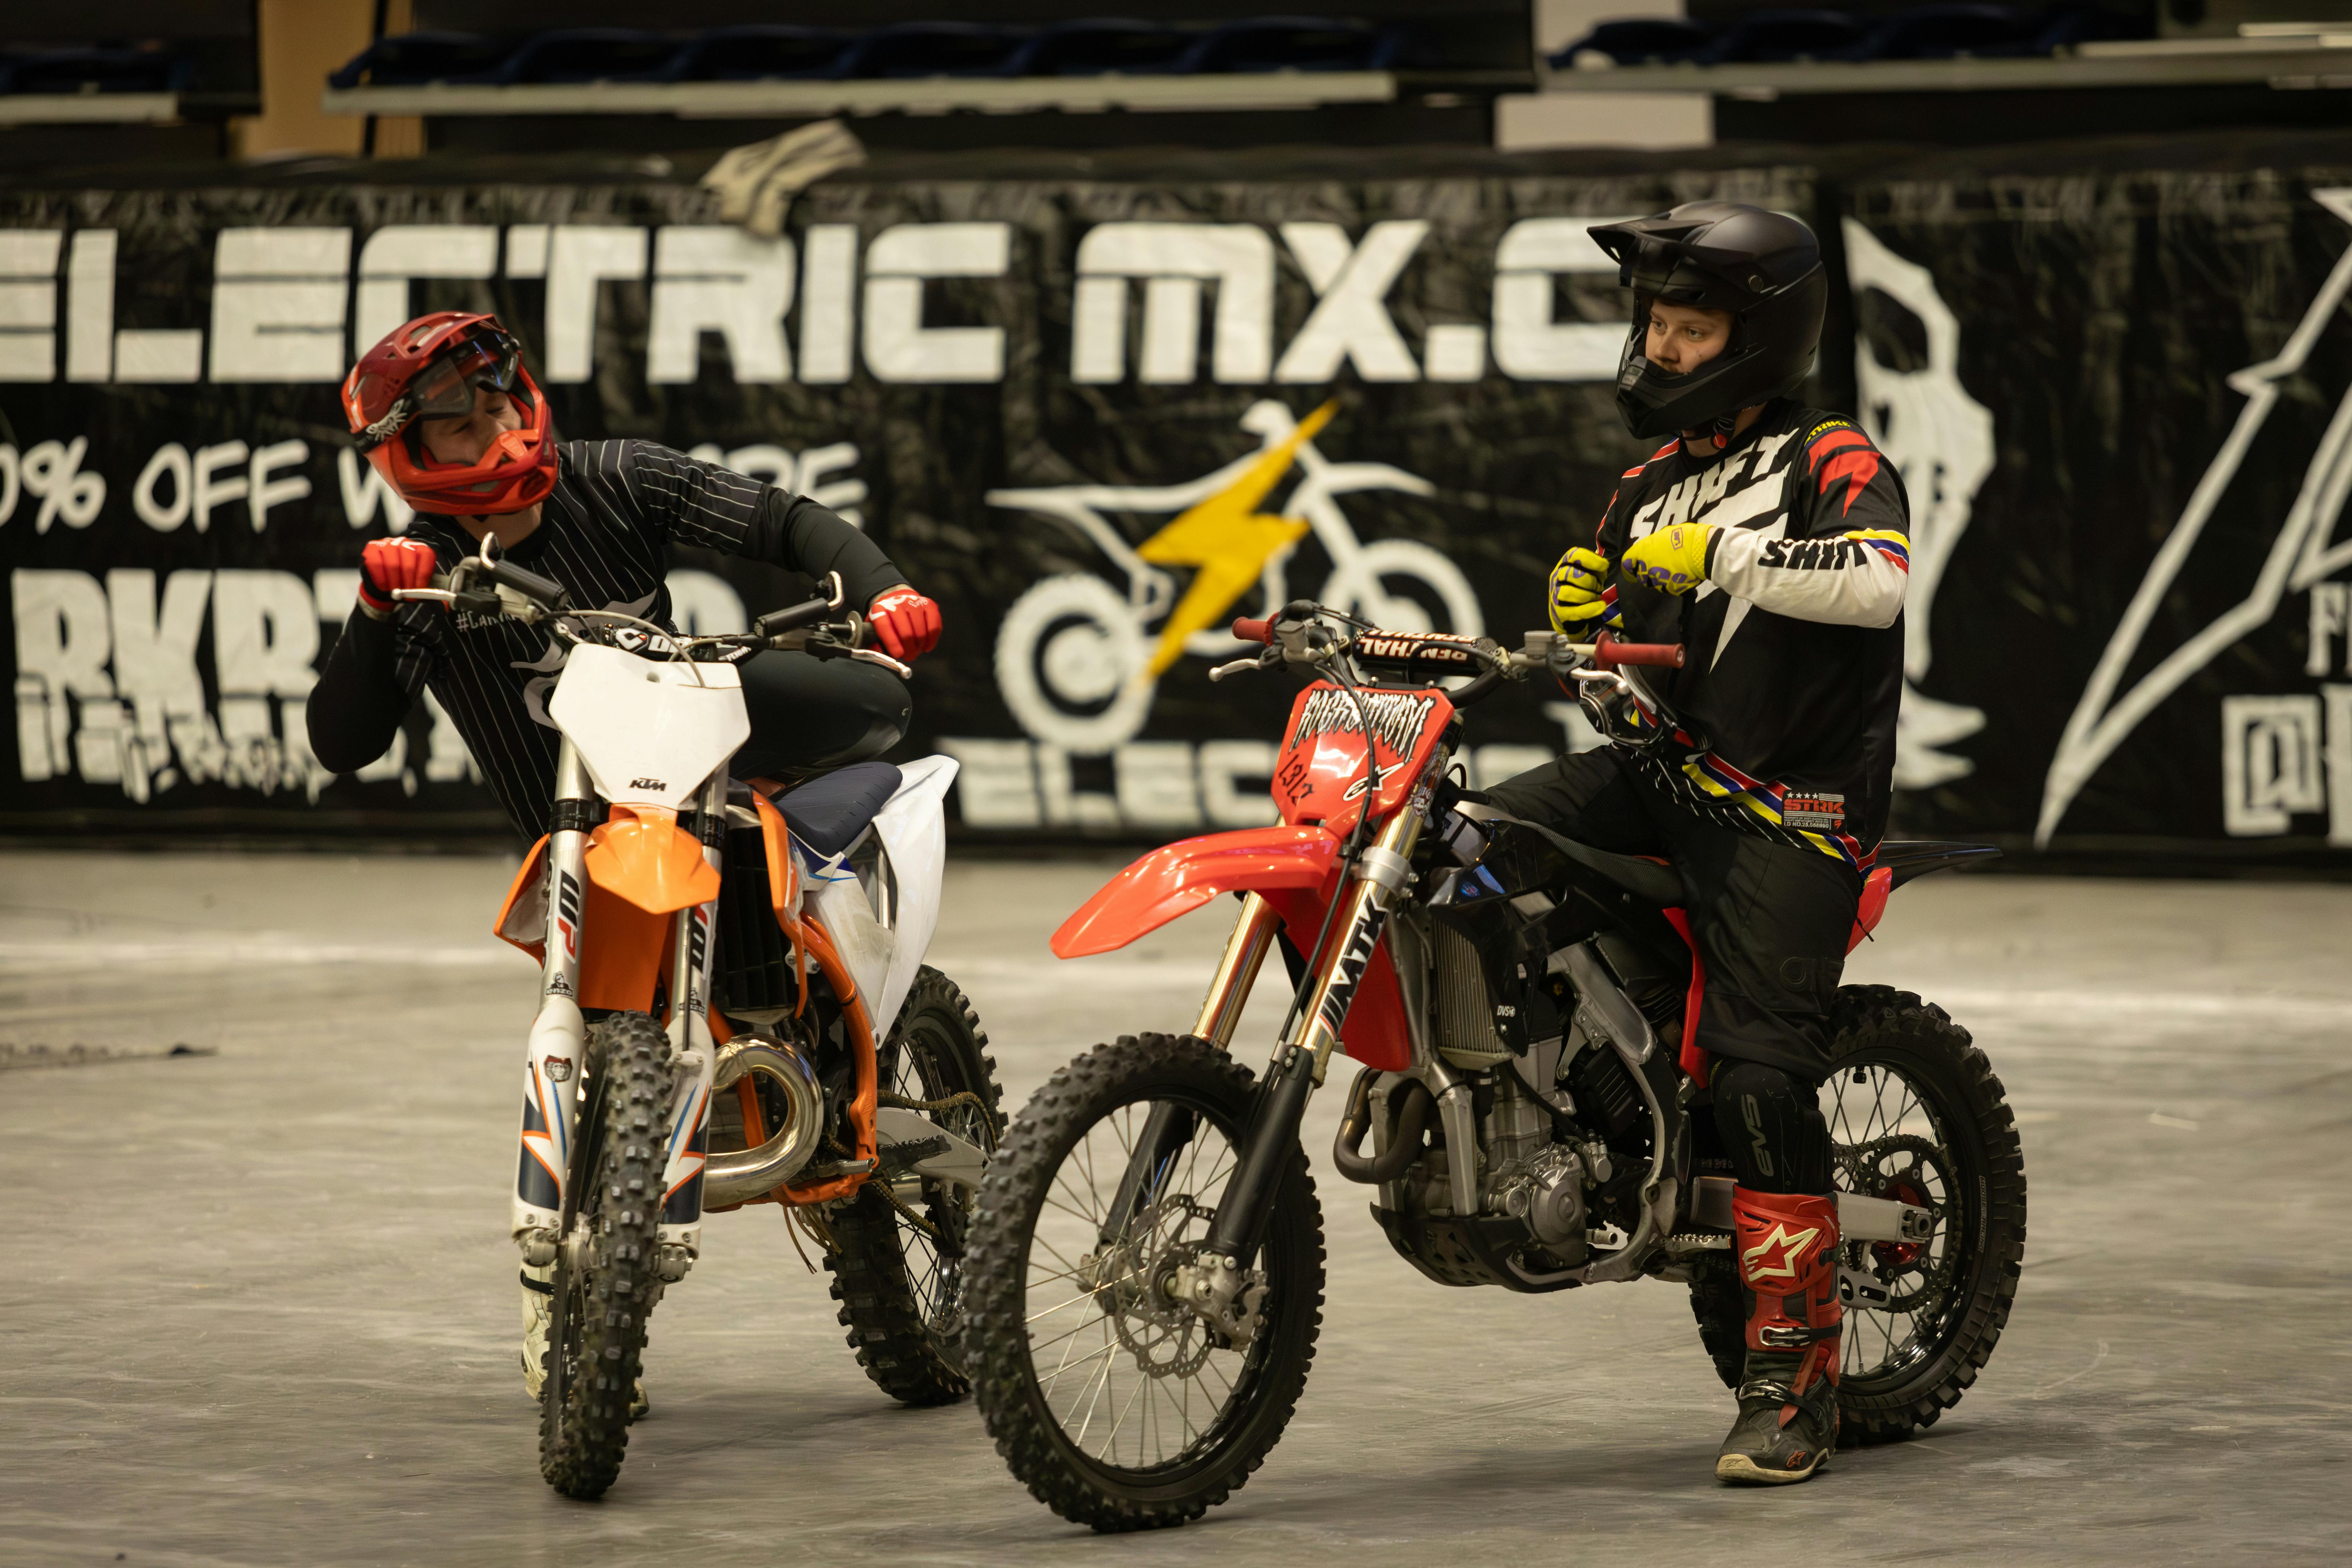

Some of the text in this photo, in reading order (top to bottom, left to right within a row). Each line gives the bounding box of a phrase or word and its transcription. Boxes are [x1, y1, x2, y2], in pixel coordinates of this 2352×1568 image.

[133, 439, 312, 534] OFF
[629, 778, 667, 791] KTM
[1784, 799, 1844, 814] STRK
[1497, 1005, 1509, 1017] DVS
